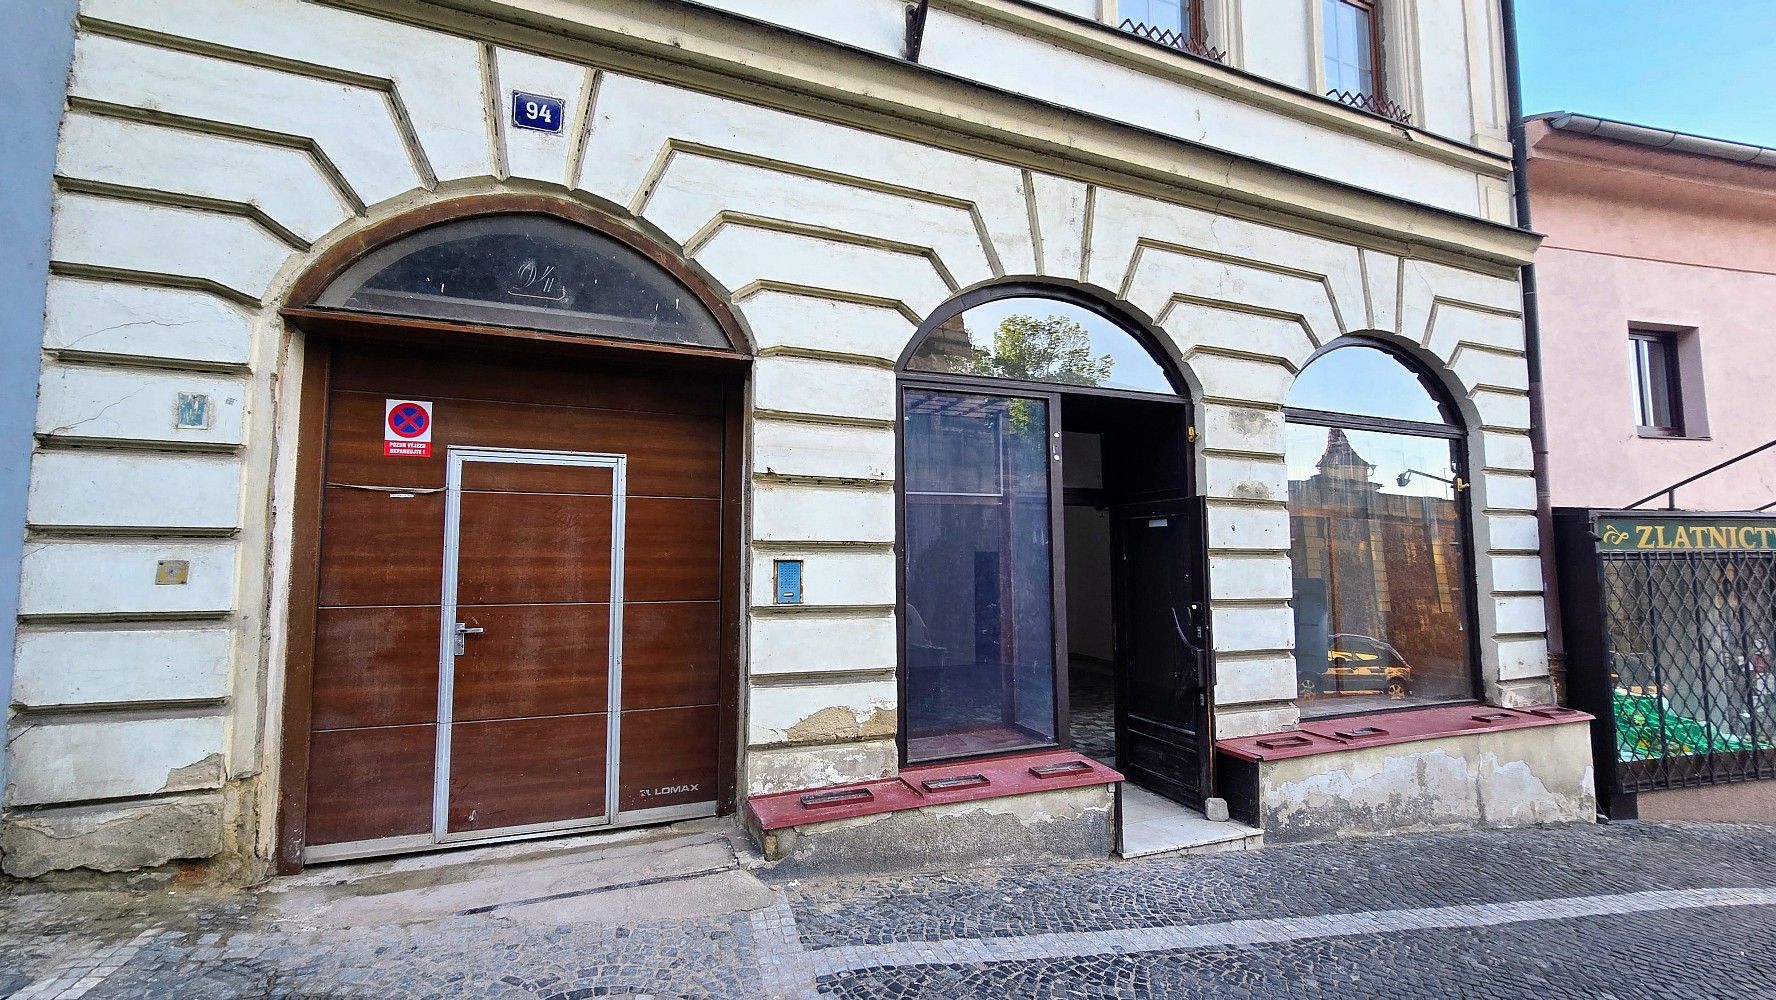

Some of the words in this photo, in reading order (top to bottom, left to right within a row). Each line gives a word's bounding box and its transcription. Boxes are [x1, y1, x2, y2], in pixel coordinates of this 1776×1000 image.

[526, 101, 552, 123] 94
[1635, 525, 1776, 549] ZLATNICT
[654, 783, 699, 796] LOMAX
